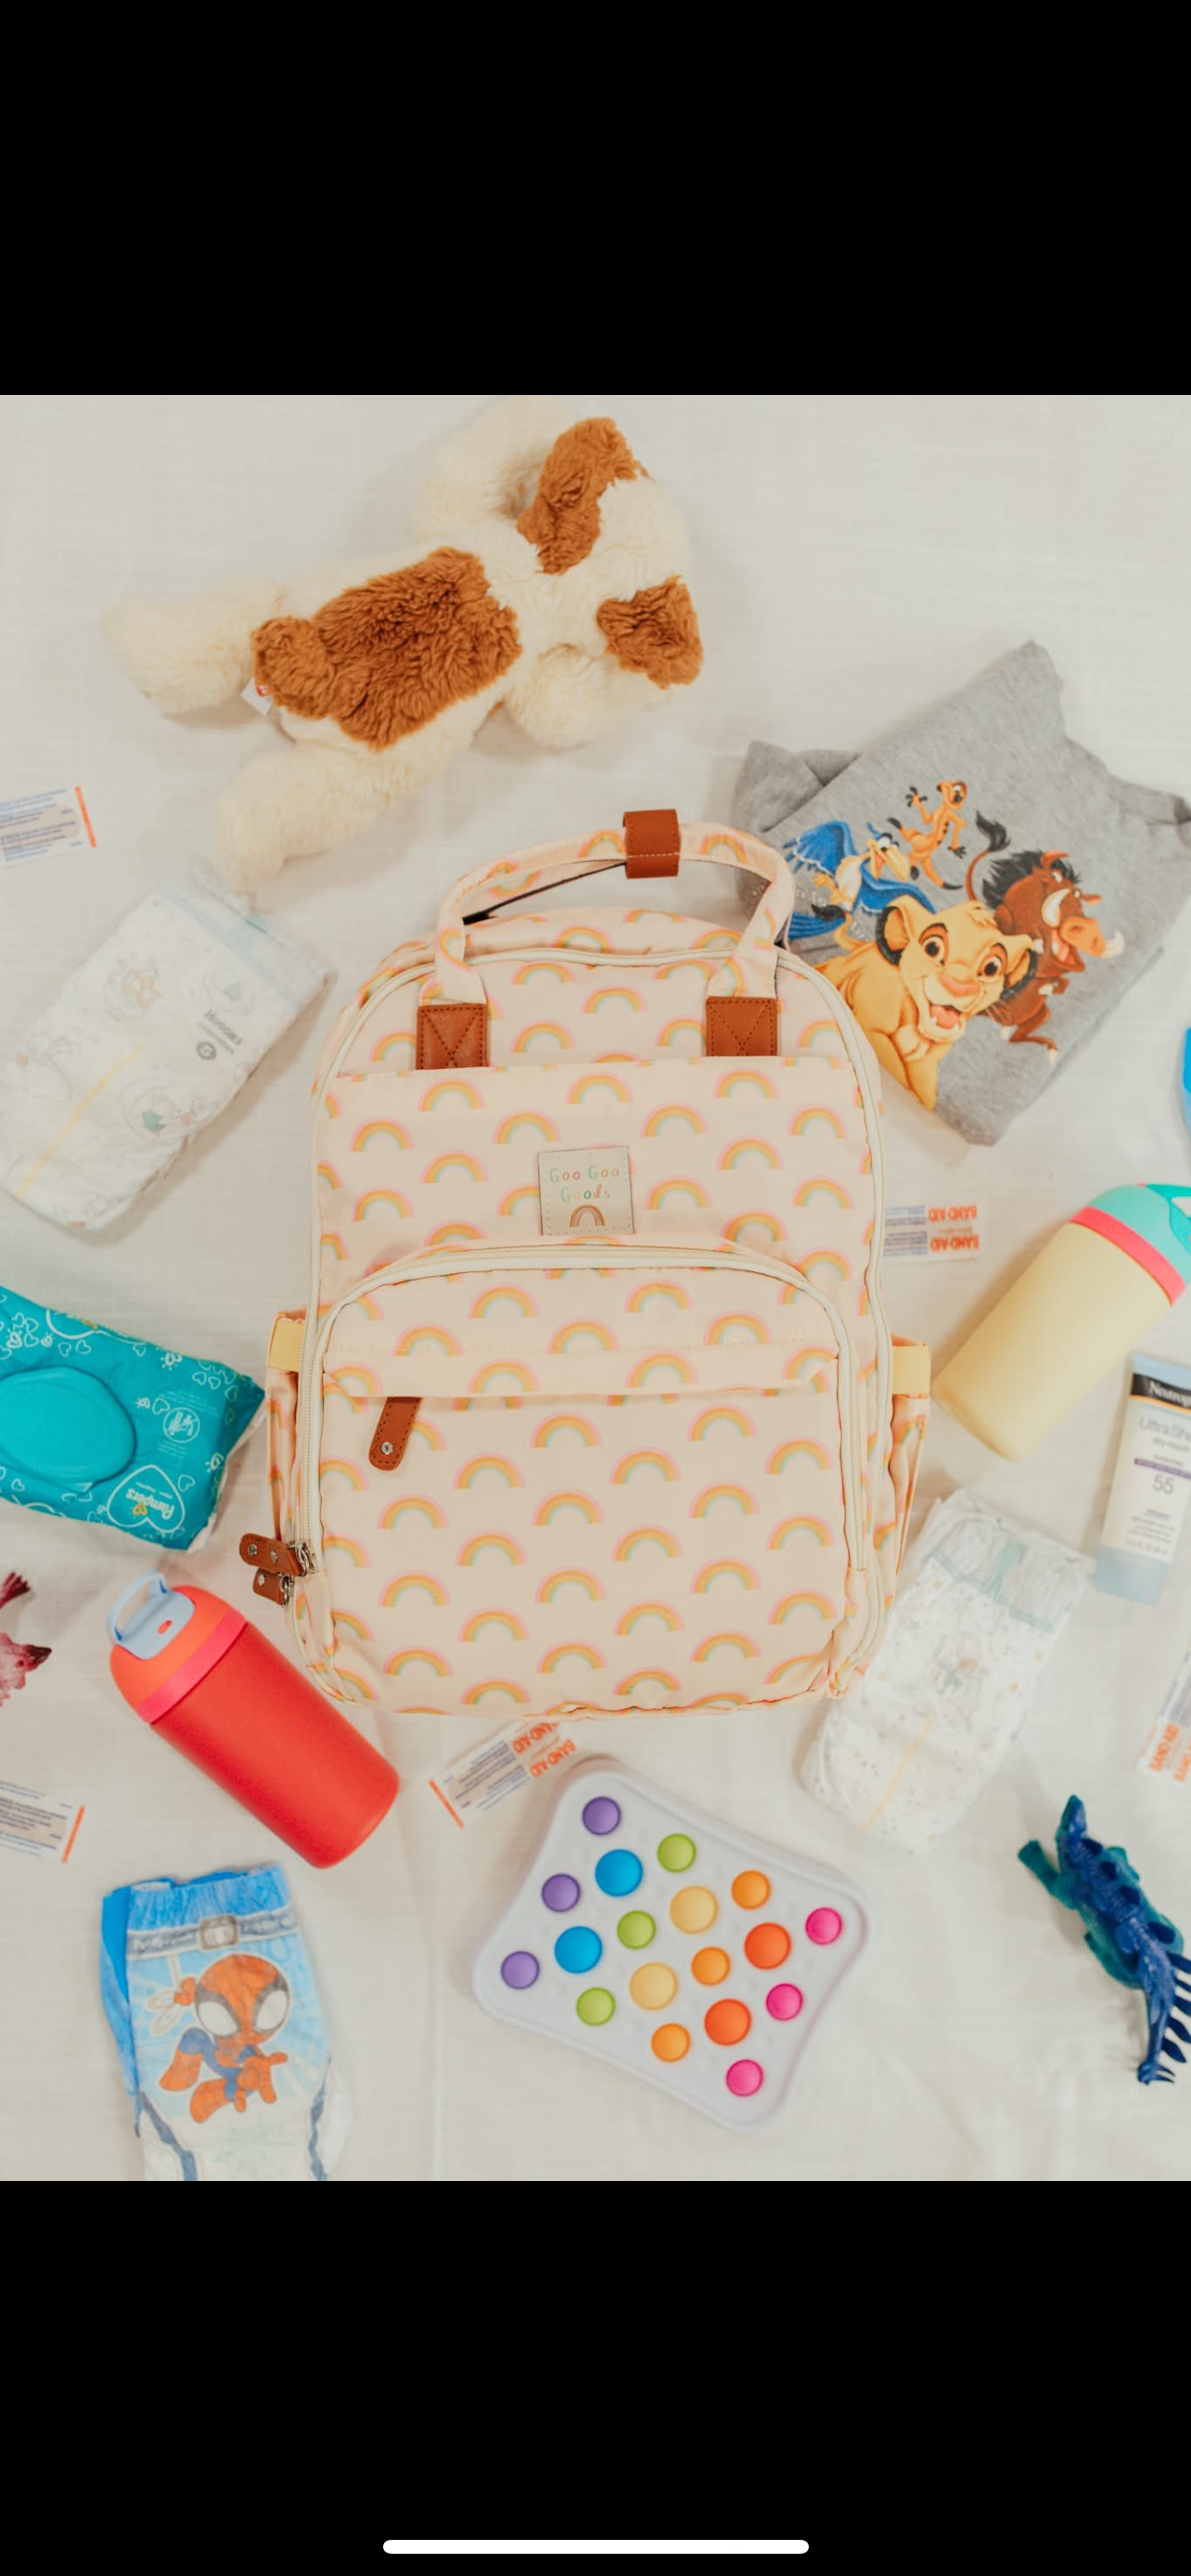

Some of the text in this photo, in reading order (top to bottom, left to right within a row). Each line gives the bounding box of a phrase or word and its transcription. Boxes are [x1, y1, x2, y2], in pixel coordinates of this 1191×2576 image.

[548, 1164, 620, 1183] Goo Goo
[560, 1183, 611, 1204] Goods
[929, 1233, 979, 1252] BAND-AID
[1152, 1473, 1174, 1495] 55
[125, 1487, 174, 1520] Pampers
[530, 1739, 577, 1778] BAND-AID
